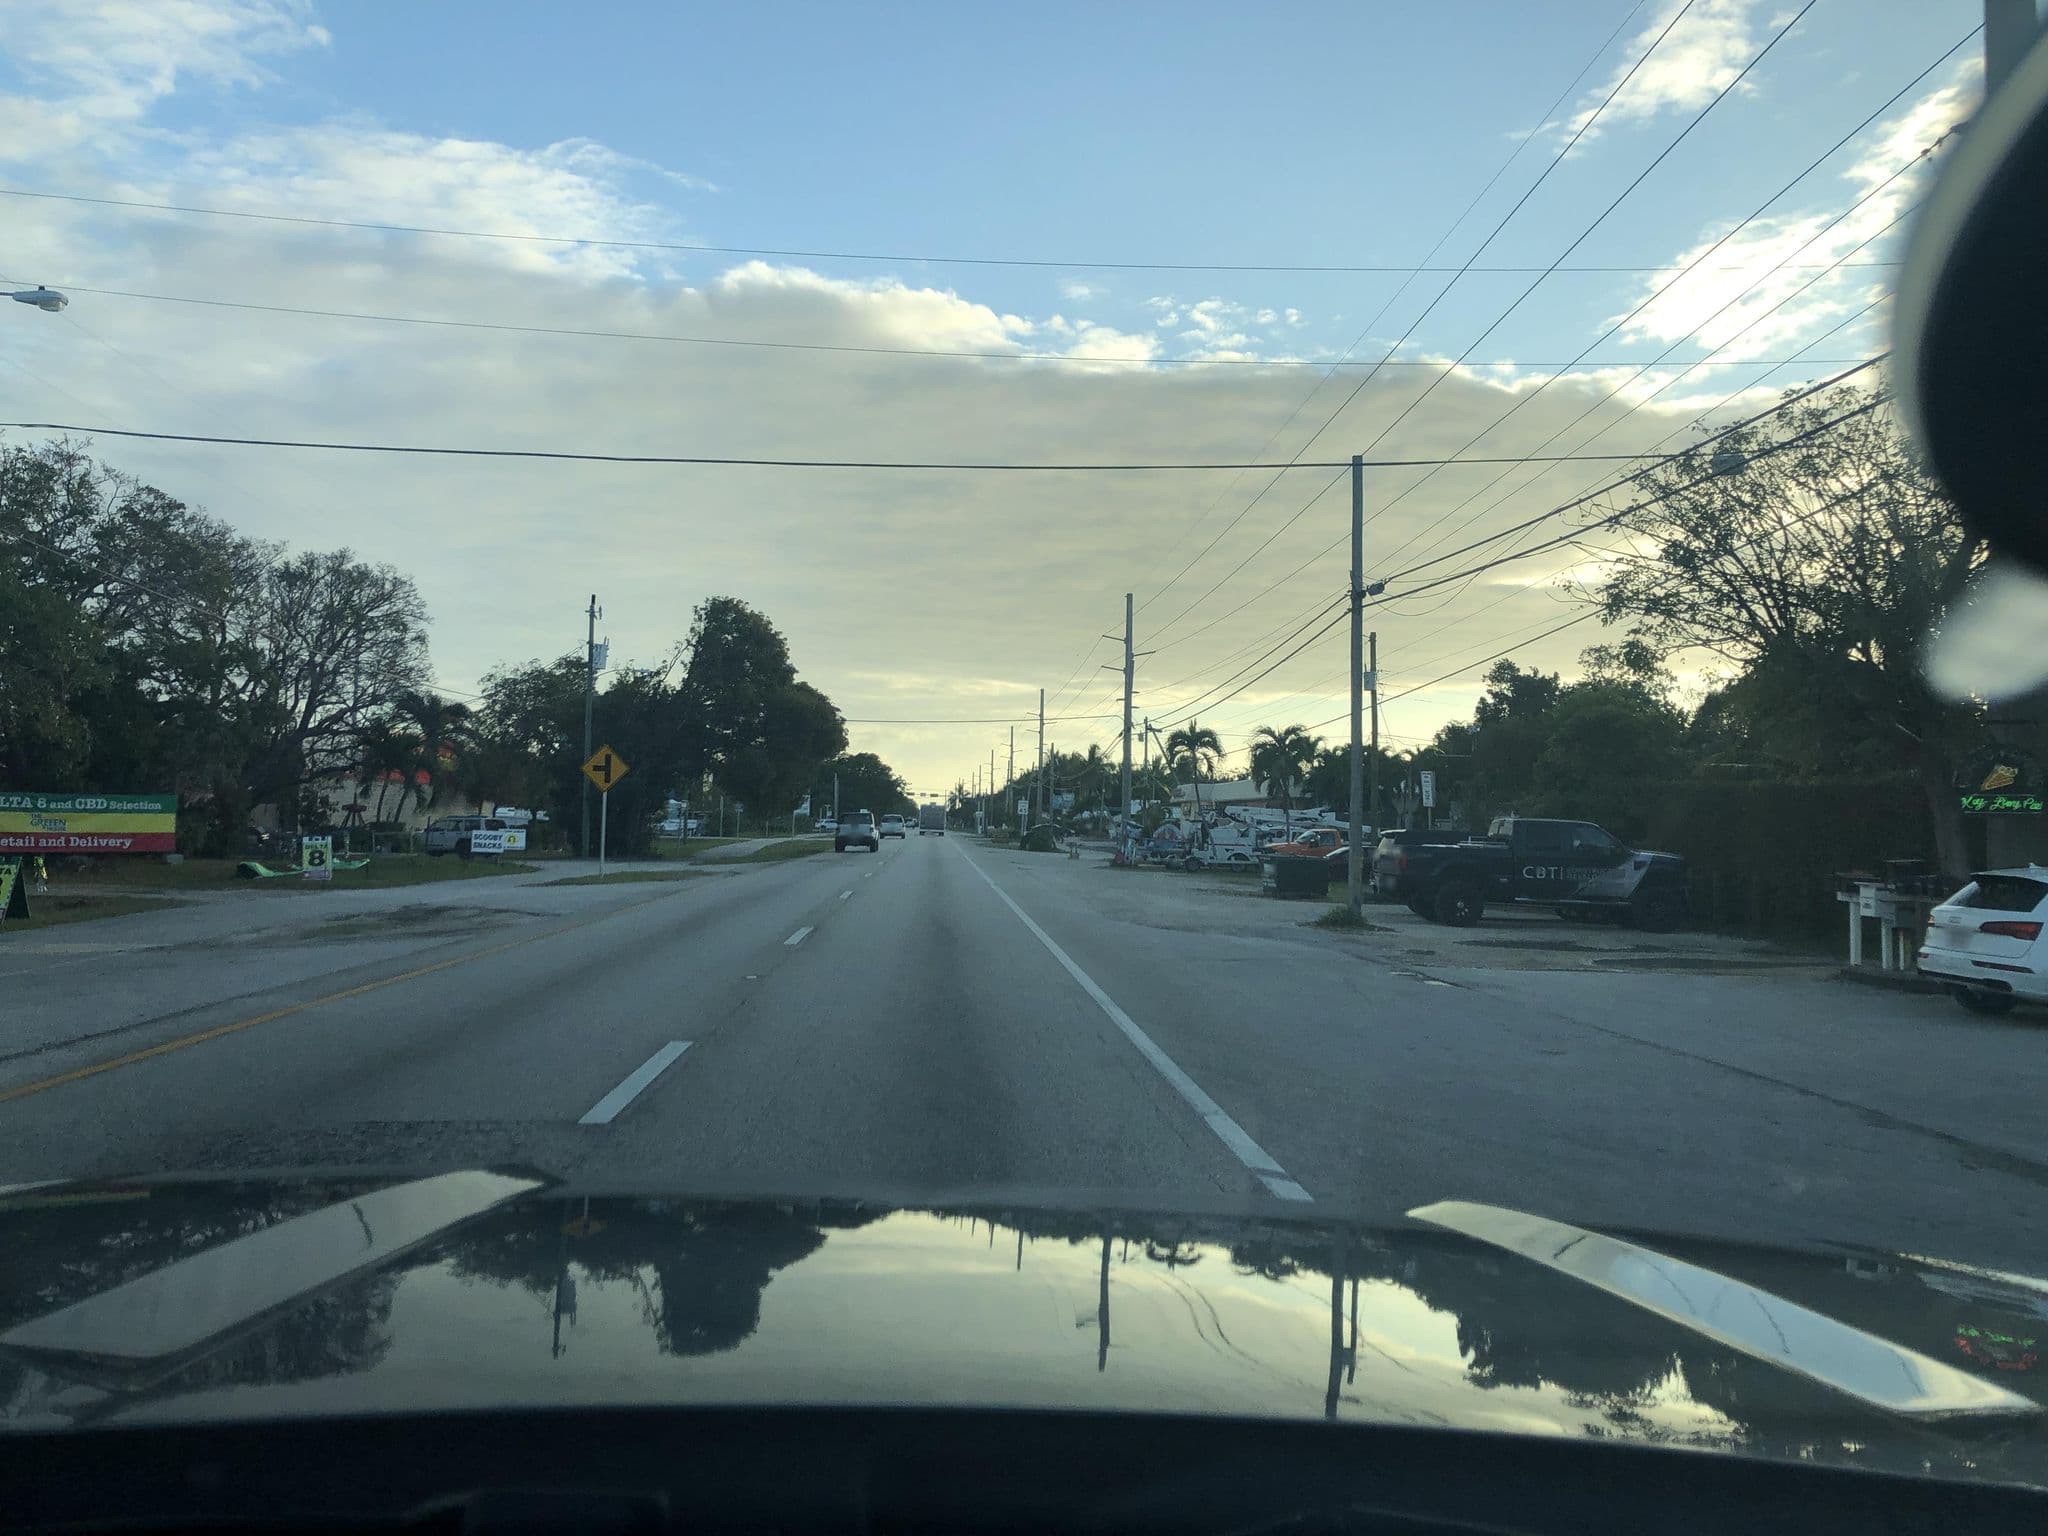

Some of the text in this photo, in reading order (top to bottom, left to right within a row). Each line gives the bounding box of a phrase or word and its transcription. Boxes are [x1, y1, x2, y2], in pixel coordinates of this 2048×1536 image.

[37, 797, 47, 809] 8
[50, 801, 72, 809] and
[75, 798, 107, 809] CBD
[109, 801, 162, 810] Selection
[38, 836, 66, 847] and
[69, 836, 133, 849] Delivery
[308, 850, 325, 867] 8
[1522, 866, 1558, 879] CBT
